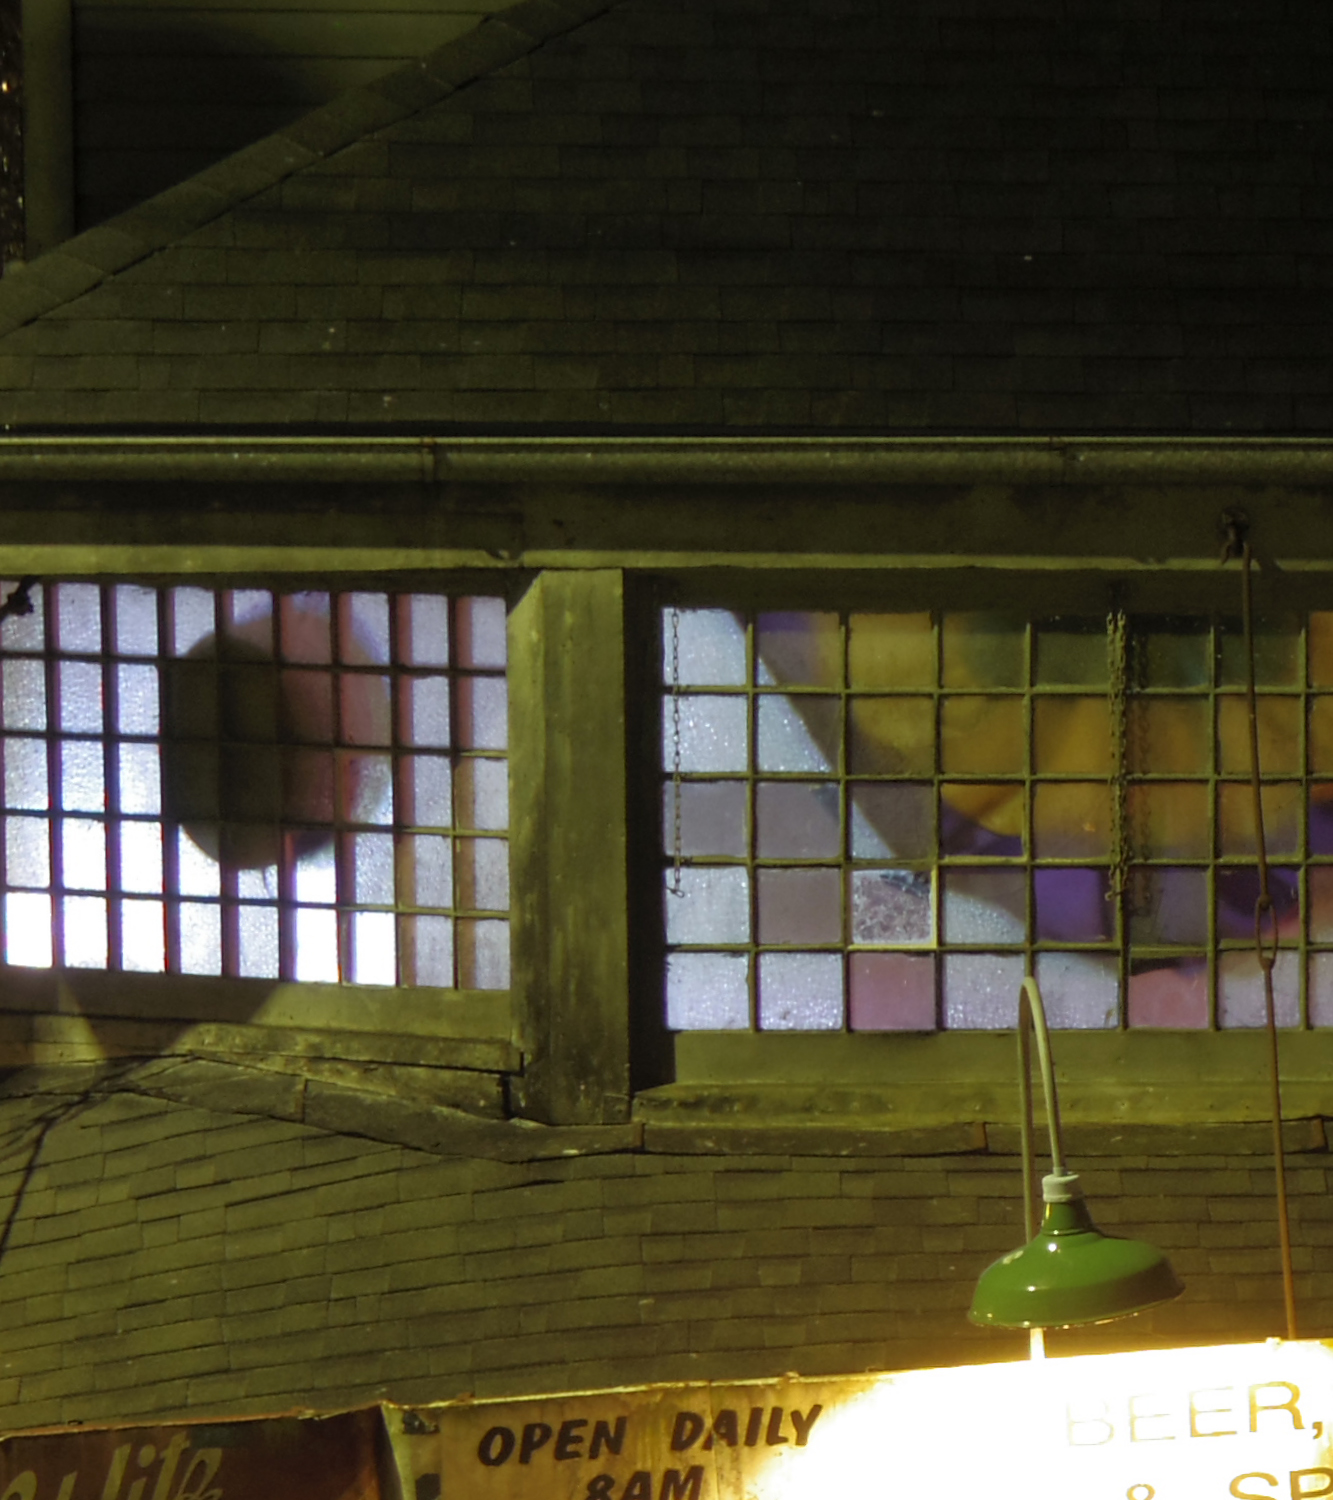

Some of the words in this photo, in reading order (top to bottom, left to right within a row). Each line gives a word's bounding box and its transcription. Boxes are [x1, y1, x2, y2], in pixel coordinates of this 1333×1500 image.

[478, 1416, 626, 1466] OPEN
[671, 1404, 822, 1451] DAILY
[1066, 1380, 1325, 1447] BEER,
